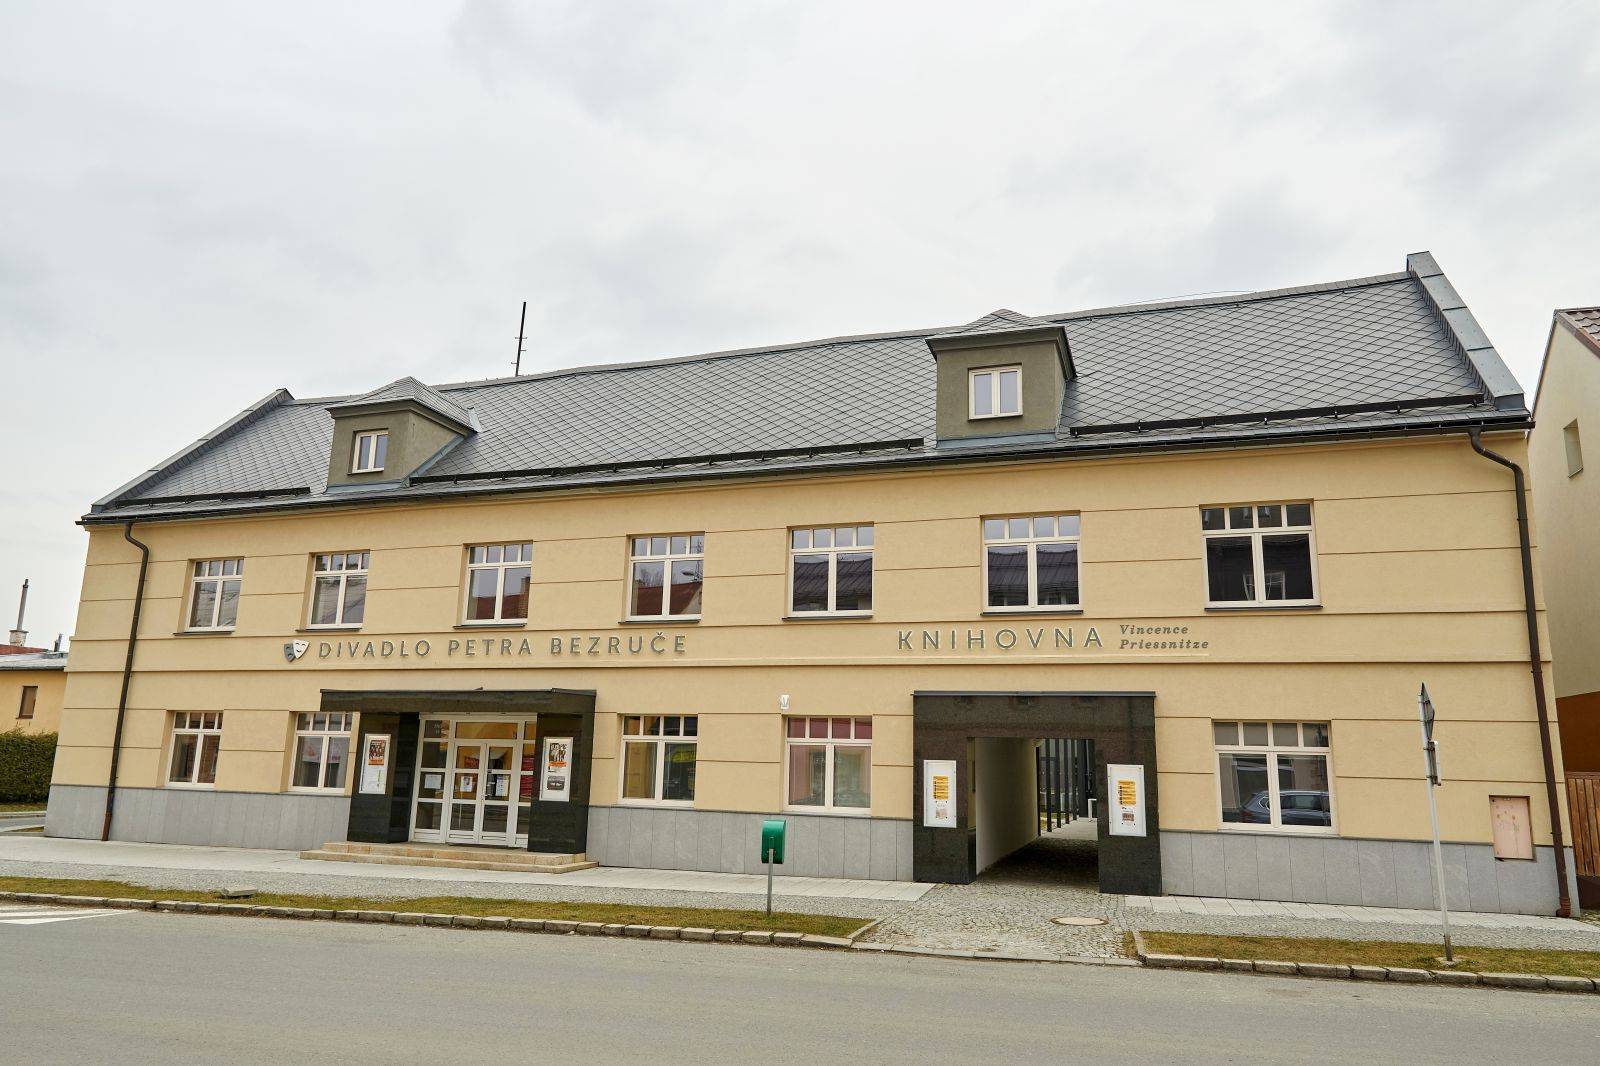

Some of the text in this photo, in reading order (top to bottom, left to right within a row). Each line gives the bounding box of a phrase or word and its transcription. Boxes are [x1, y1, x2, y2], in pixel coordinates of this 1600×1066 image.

[1119, 624, 1189, 635] Vincence
[318, 632, 686, 658] DIVADLO PETRA BEZRUČE
[898, 627, 1103, 650] KNIHOVNA
[1119, 639, 1209, 650] Priessnitze
